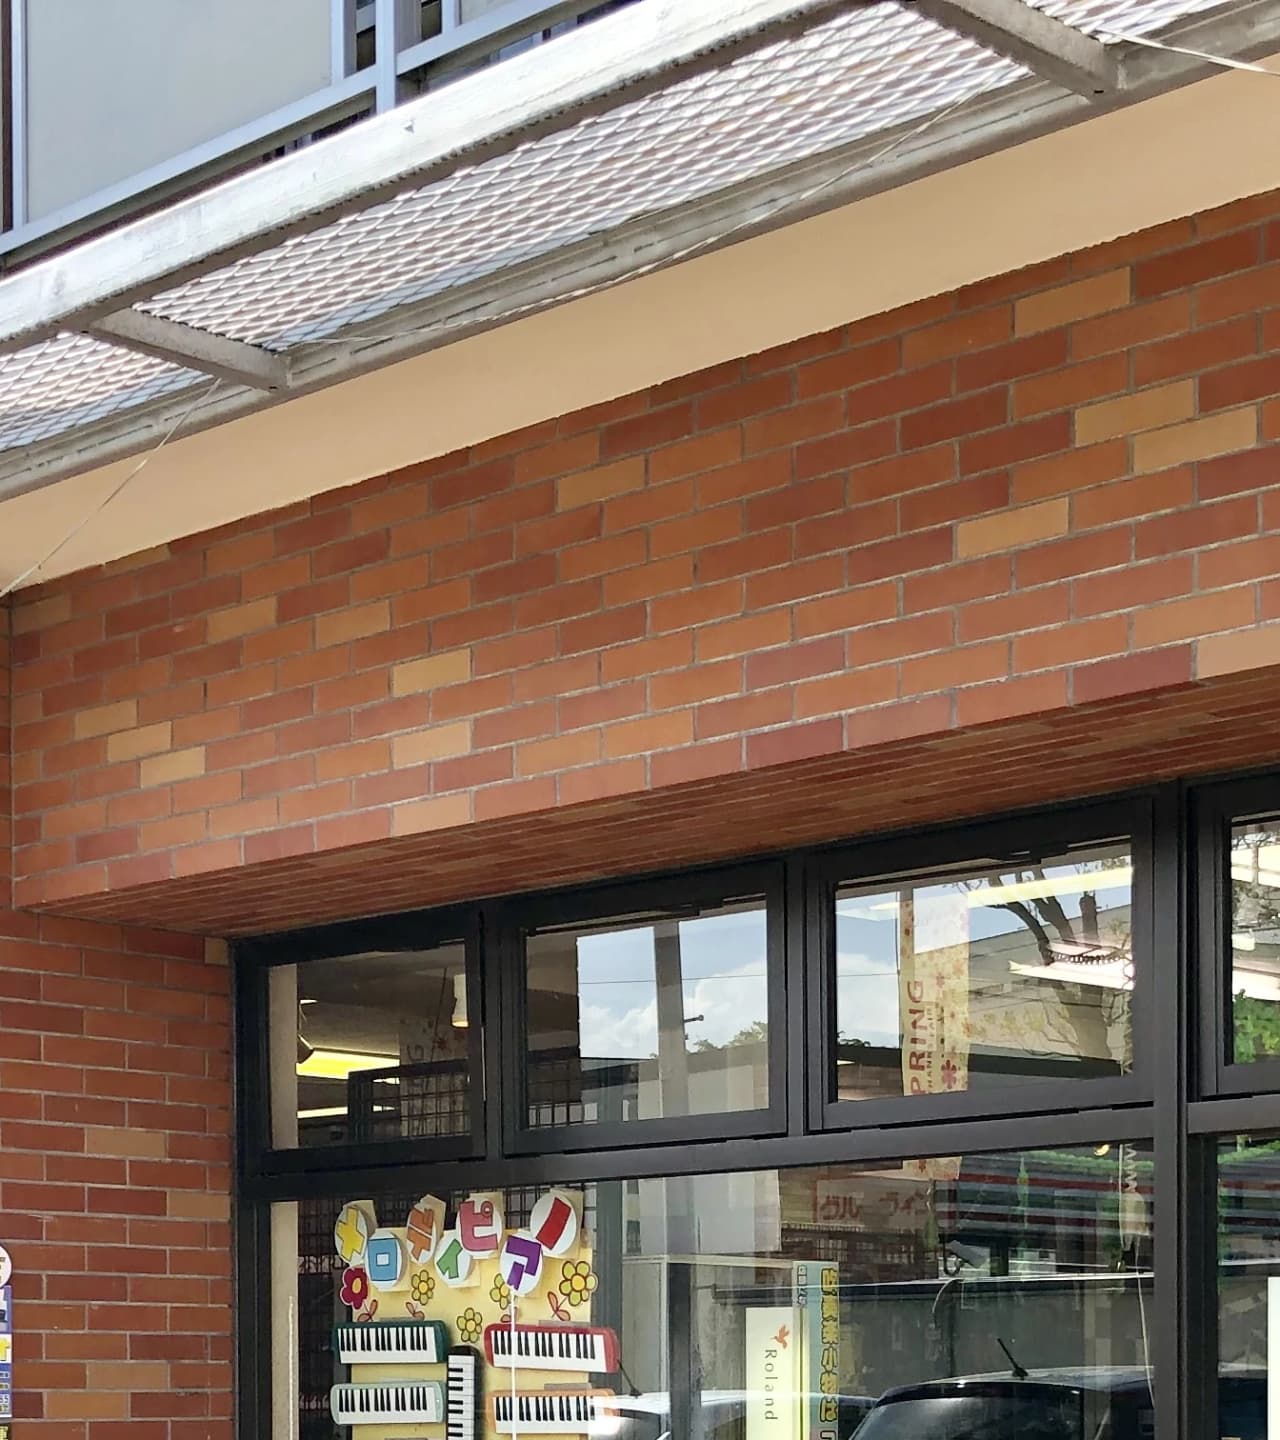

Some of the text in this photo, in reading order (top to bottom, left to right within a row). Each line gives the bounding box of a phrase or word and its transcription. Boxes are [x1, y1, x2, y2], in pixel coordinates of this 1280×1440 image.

[335, 1196, 573, 1292] メロディピアノ
[764, 1349, 778, 1421] Roland
